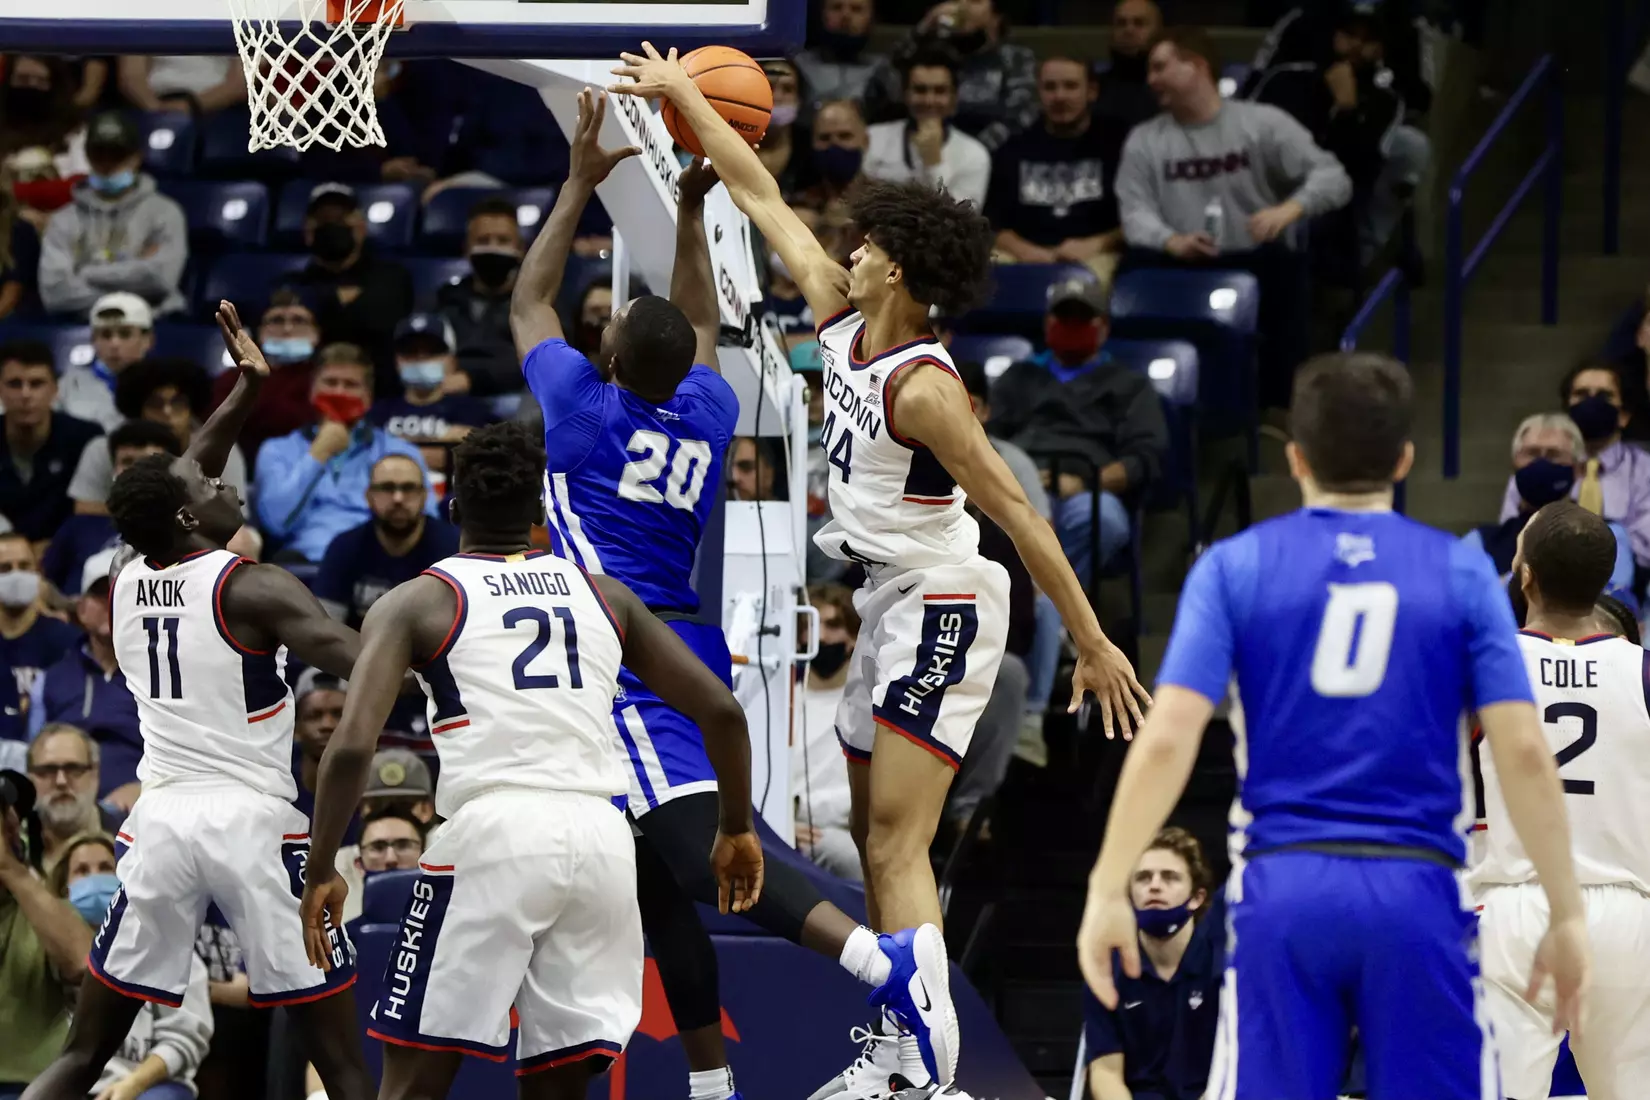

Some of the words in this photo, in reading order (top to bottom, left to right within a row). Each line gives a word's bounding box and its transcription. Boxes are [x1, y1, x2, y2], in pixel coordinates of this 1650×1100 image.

[823, 360, 882, 441] UCONN
[617, 429, 712, 513] 20
[820, 410, 853, 484] 44
[136, 579, 186, 607] AKOK
[483, 572, 571, 596] SANOGO
[142, 617, 183, 699] 11
[502, 606, 583, 690] 21
[899, 613, 962, 716] HUSKIES
[1310, 580, 1400, 698] 0
[1540, 658, 1598, 688] COLE
[1544, 702, 1598, 795] 2
[384, 880, 434, 1019] HUSKIES
